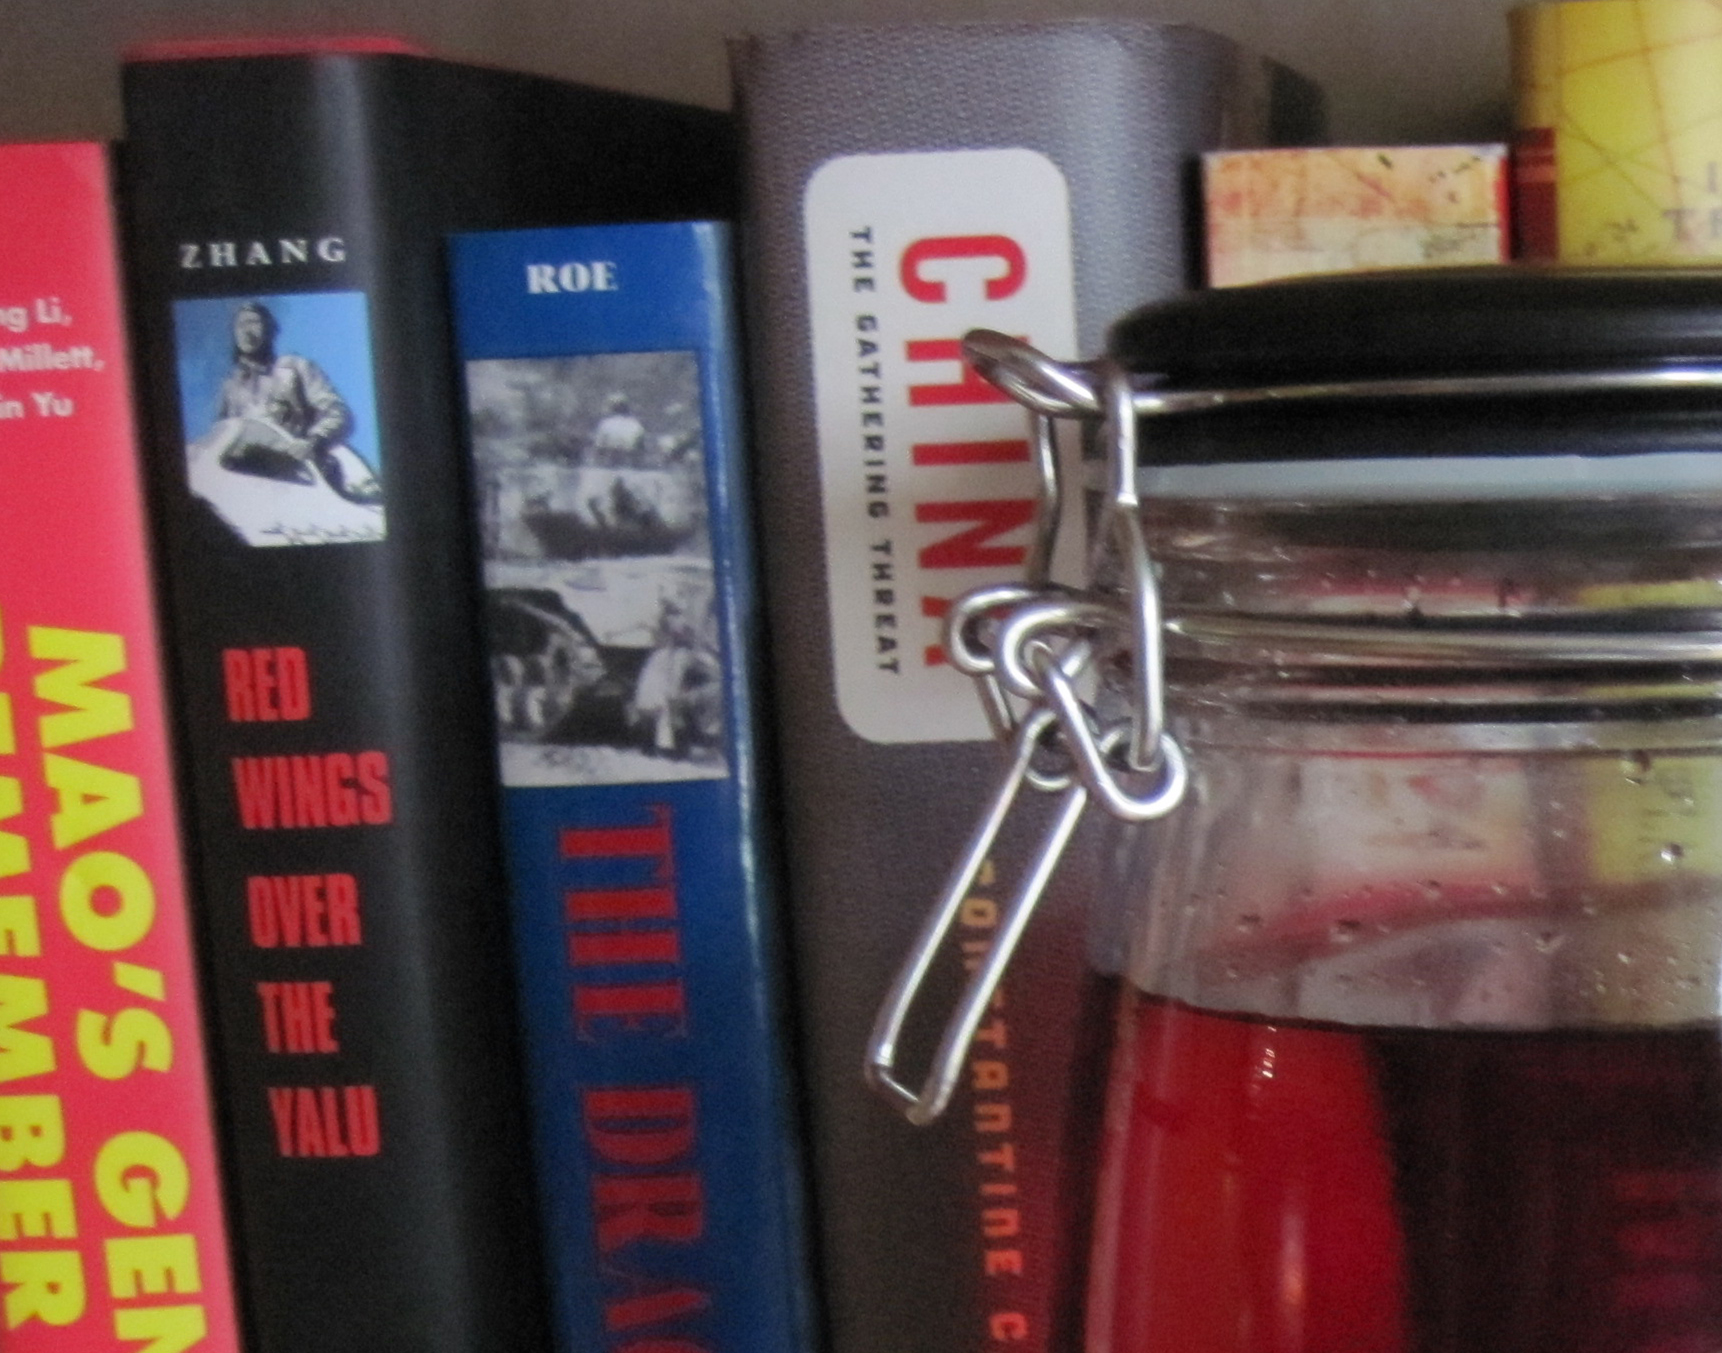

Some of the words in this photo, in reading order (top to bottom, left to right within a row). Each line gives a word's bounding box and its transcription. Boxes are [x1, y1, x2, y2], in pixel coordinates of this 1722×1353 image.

[179, 236, 348, 270] ZHANG
[527, 260, 619, 295] ROE
[849, 226, 874, 293] THE
[34, 296, 73, 327] Li,
[32, 391, 74, 418] Yu
[856, 314, 889, 519] GATHERING
[870, 538, 899, 674] THREAT
[222, 646, 312, 722] RED
[231, 750, 394, 829] WINGS
[26, 625, 174, 1081] MAO'S
[247, 873, 363, 949] OVER
[558, 802, 690, 1042] THE
[257, 980, 340, 1055] THE
[960, 856, 1024, 1276] ONTANTINE
[268, 1084, 382, 1159] YALU
